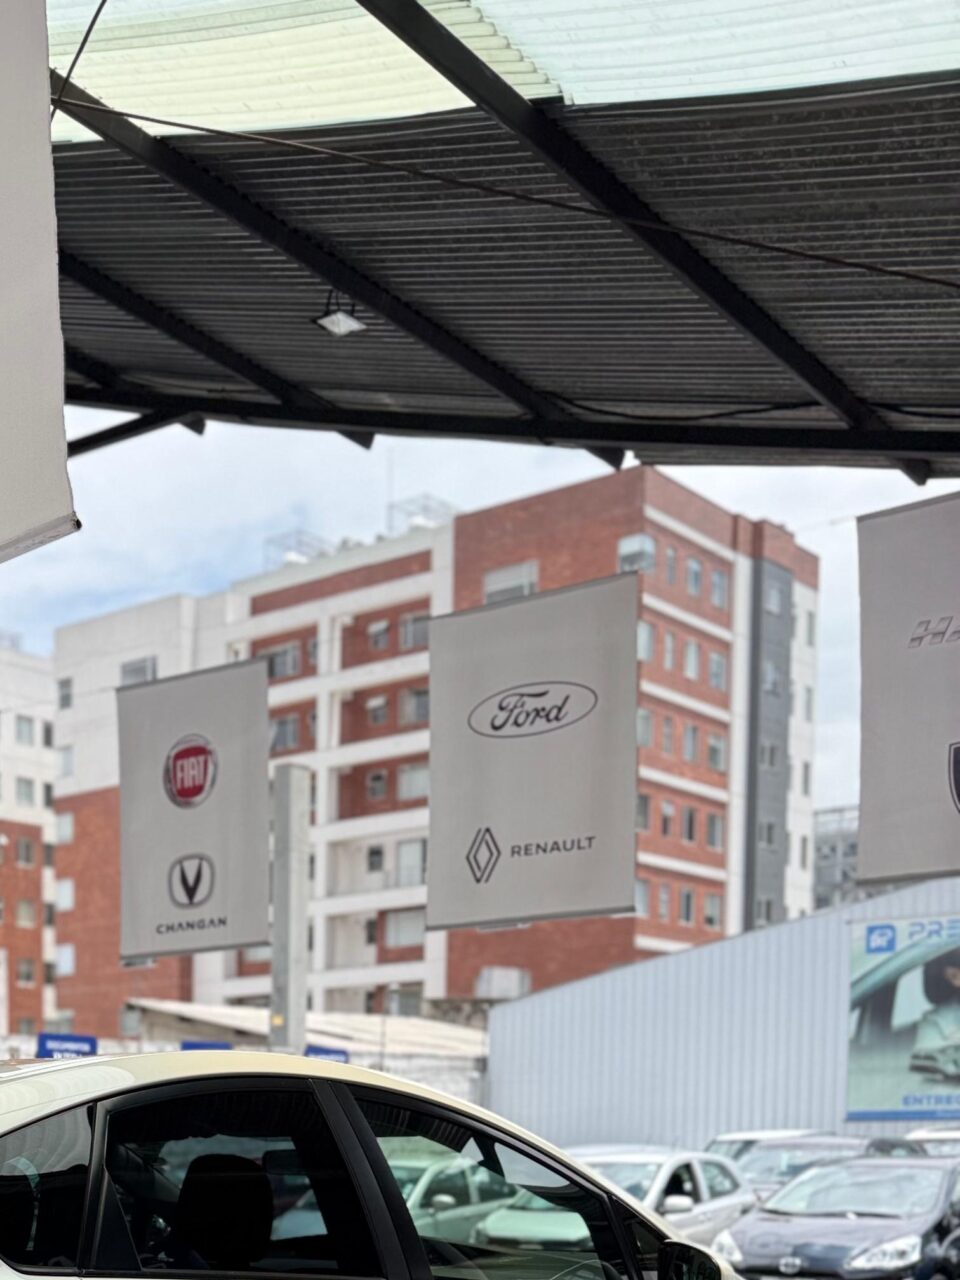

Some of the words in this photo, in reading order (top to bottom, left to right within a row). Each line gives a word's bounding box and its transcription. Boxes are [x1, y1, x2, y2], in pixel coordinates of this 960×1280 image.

[490, 690, 571, 731] Ford
[177, 754, 207, 790] FIAT
[510, 836, 597, 858] RENAULT
[155, 917, 228, 935] CHANGAN
